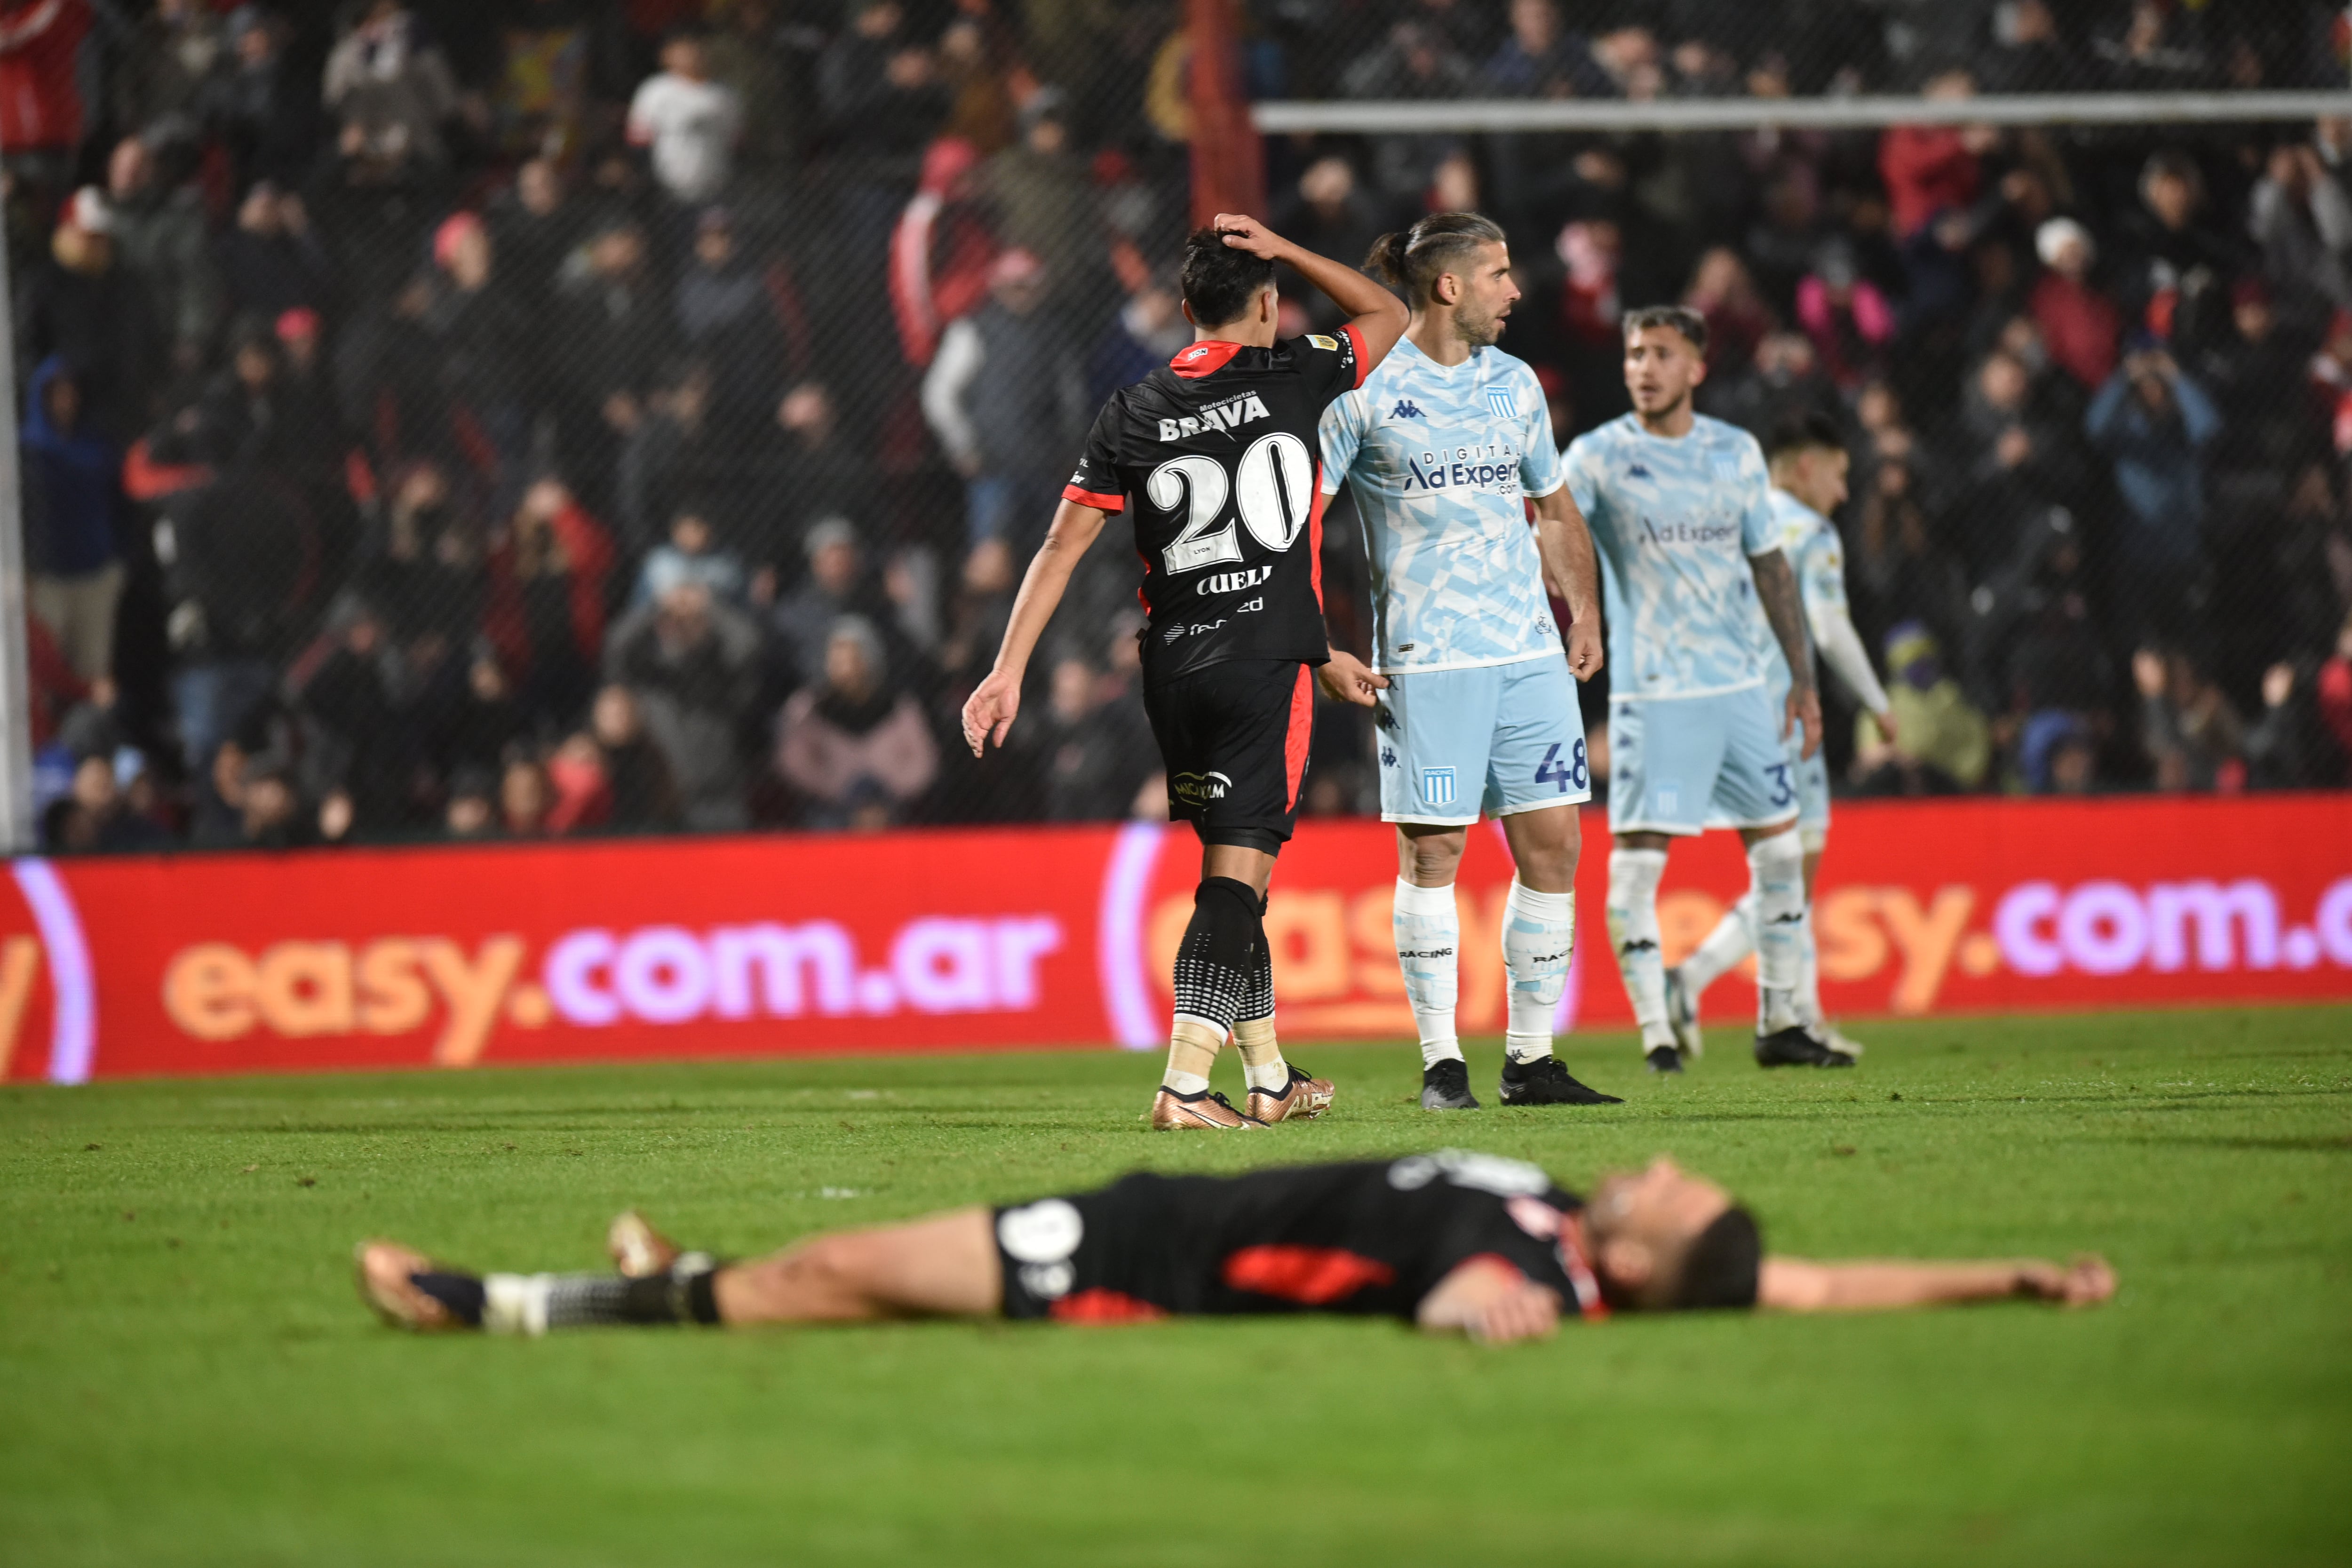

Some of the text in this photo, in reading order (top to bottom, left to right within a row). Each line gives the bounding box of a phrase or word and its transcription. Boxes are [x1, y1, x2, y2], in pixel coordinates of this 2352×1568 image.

[1157, 396, 1271, 442] BRAVA
[1200, 390, 1257, 412] Motocicletas
[1147, 432, 1313, 575] 20
[1535, 737, 1586, 793] 48
[1399, 947, 1453, 959] RACING
